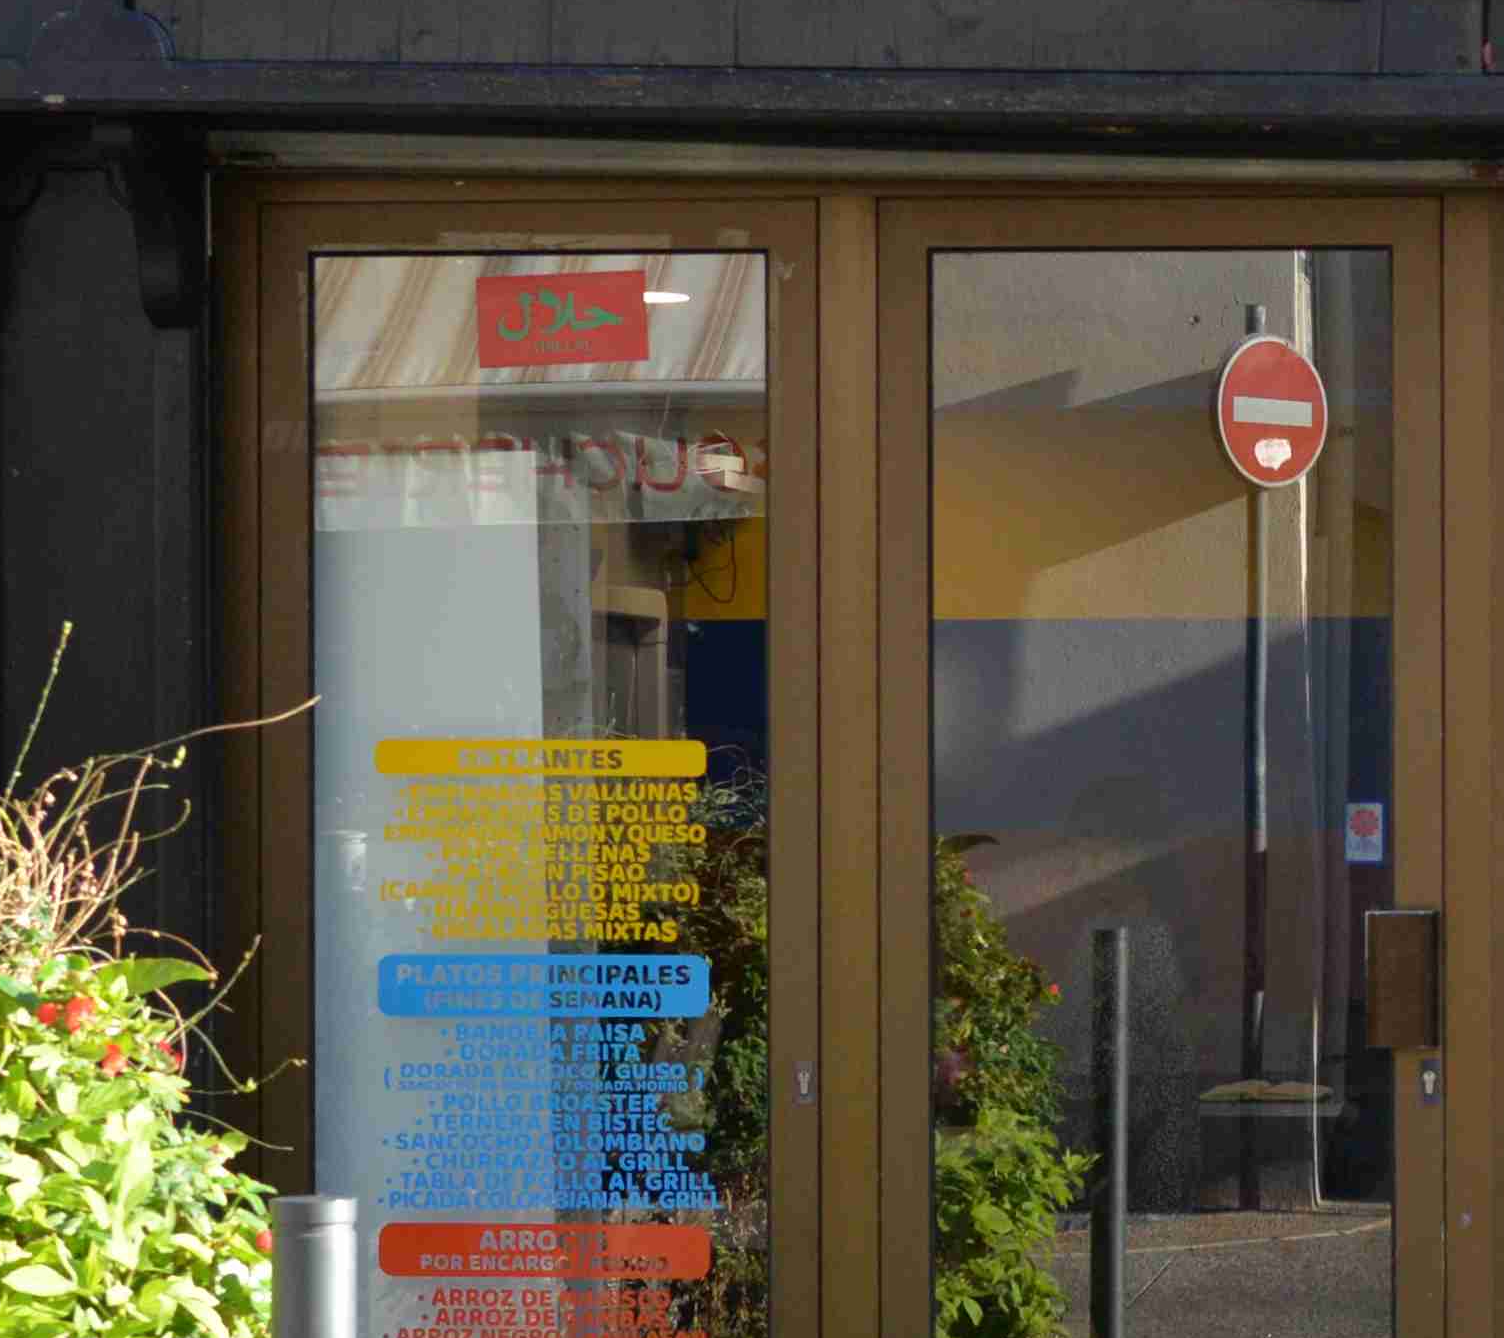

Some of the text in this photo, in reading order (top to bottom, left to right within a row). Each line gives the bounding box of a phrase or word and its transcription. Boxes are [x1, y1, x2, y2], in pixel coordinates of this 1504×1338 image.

[497, 287, 624, 341] حلال
[570, 782, 698, 802] VALLUNAS
[568, 804, 601, 823] DE
[606, 804, 686, 823] POLLO
[531, 825, 606, 843] AMON
[611, 825, 624, 842] Y
[628, 825, 706, 844] QUESO
[530, 845, 652, 863] ELLENAS
[448, 864, 645, 882] PATAN PISAO
[590, 885, 605, 902] O
[612, 883, 701, 905] MIXTO)
[433, 903, 640, 921] HAMGUESAS
[583, 921, 678, 941] MIXTAS
[396, 964, 691, 986] PLATOS PRINCIPALES
[549, 992, 662, 1012] SEMANA)
[574, 1023, 646, 1043] PAISA
[571, 1043, 641, 1062] FRITA
[399, 1063, 494, 1079] DORADA
[615, 1062, 686, 1079] GUISO
[573, 1081, 634, 1092] RADA
[552, 1113, 584, 1132] EN
[589, 1113, 673, 1132] BISTEC
[394, 1133, 535, 1151] SANCOCHO
[583, 1152, 613, 1171] AL
[618, 1152, 689, 1172] GRILL
[401, 1173, 478, 1191] TABLA
[608, 1172, 641, 1191] AL
[645, 1173, 716, 1191] GRILL
[389, 1191, 469, 1210] PICADA
[626, 1191, 655, 1209] AL
[660, 1191, 723, 1210] GRILL
[420, 1254, 465, 1271] POR
[469, 1254, 571, 1271] ENCARGO
[432, 1288, 672, 1309] ARROZ DE ISCO
[434, 1308, 670, 1328] ARROZ DE GBAS
